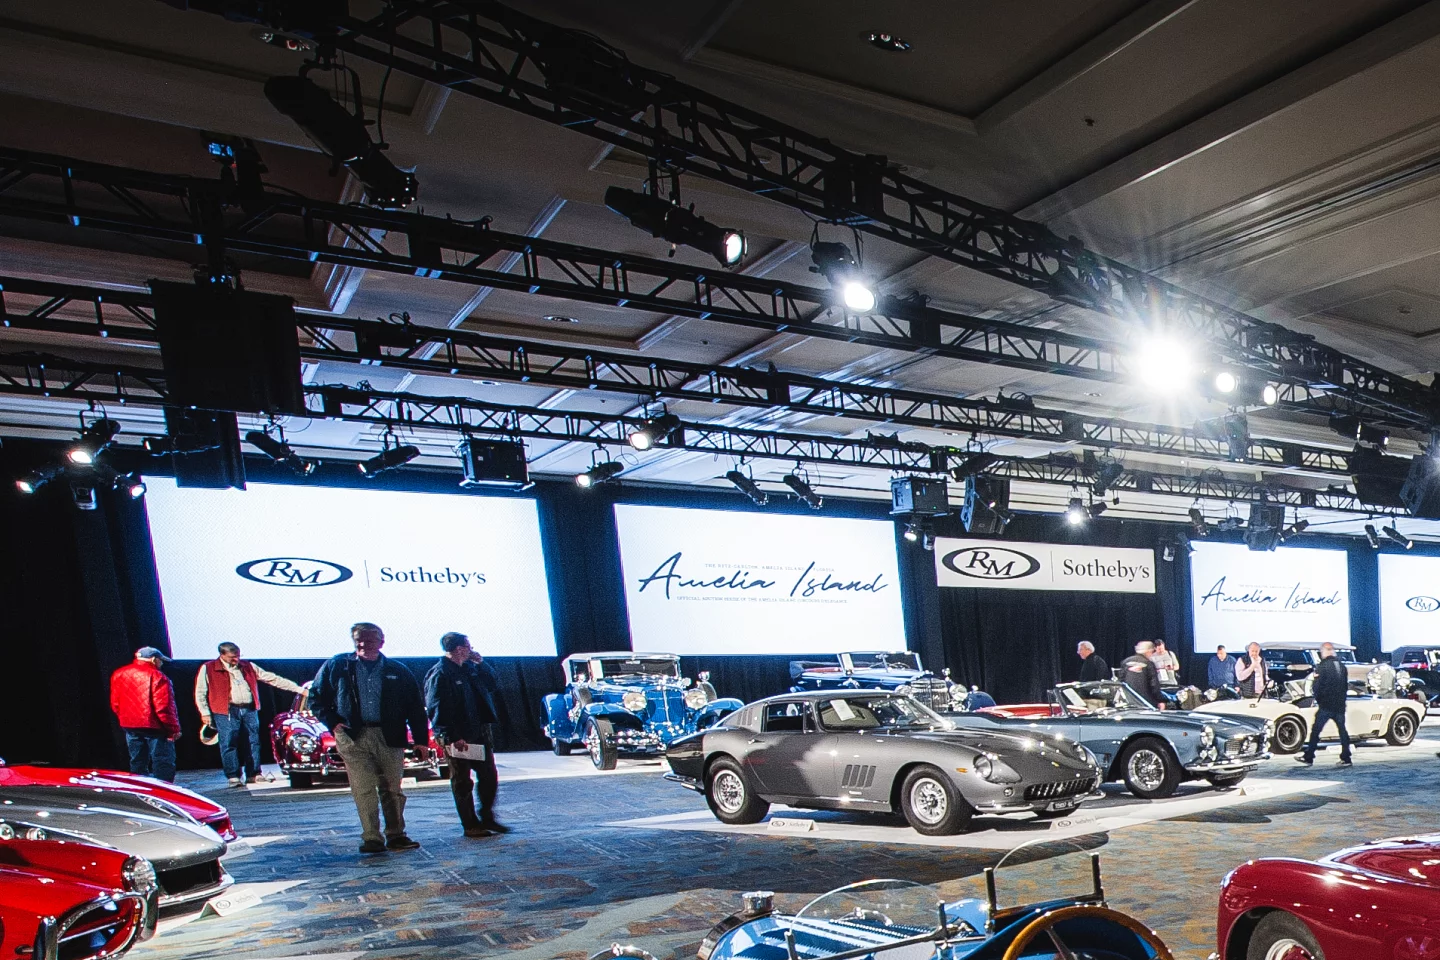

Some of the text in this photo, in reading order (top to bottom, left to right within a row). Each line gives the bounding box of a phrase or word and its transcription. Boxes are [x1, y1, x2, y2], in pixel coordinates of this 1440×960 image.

[264, 561, 487, 587] RM Sotheby's
[638, 552, 889, 600] Amelia Island
[965, 550, 1150, 582] RM Sotheby's
[1201, 576, 1342, 611] Amelia Island
[1414, 597, 1432, 611] RM
